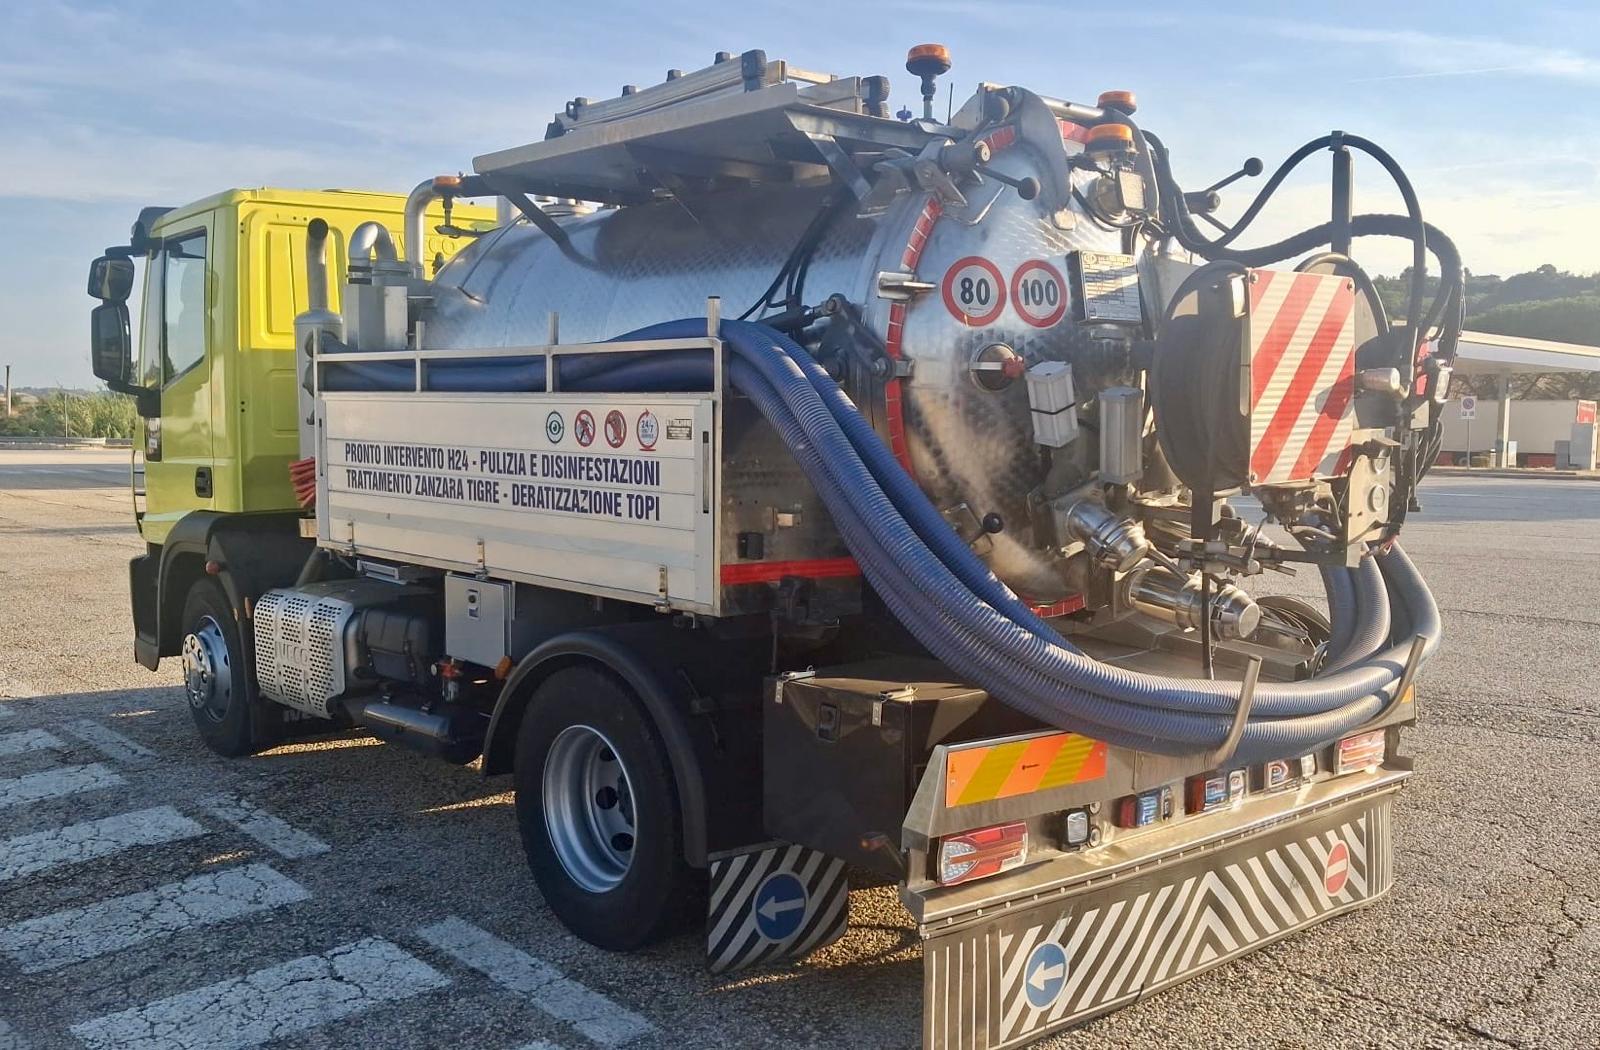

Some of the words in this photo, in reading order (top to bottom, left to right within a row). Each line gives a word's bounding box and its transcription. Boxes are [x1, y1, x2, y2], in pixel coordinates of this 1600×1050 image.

[960, 277, 991, 306] 80
[1021, 279, 1059, 307] 100
[345, 442, 381, 464] PRONTO
[384, 445, 444, 469] INTERVENTO
[447, 448, 469, 471] H24
[480, 450, 527, 476] PULIZIA
[530, 453, 538, 477] E
[541, 454, 660, 486] DISINFESTAZIONI
[346, 469, 412, 494] TRATTAMENTO
[415, 475, 464, 500] ZANZARA
[467, 479, 500, 504] TIGRE
[511, 483, 622, 517] DERATIZZAZIONE
[627, 493, 660, 521] TOPI
